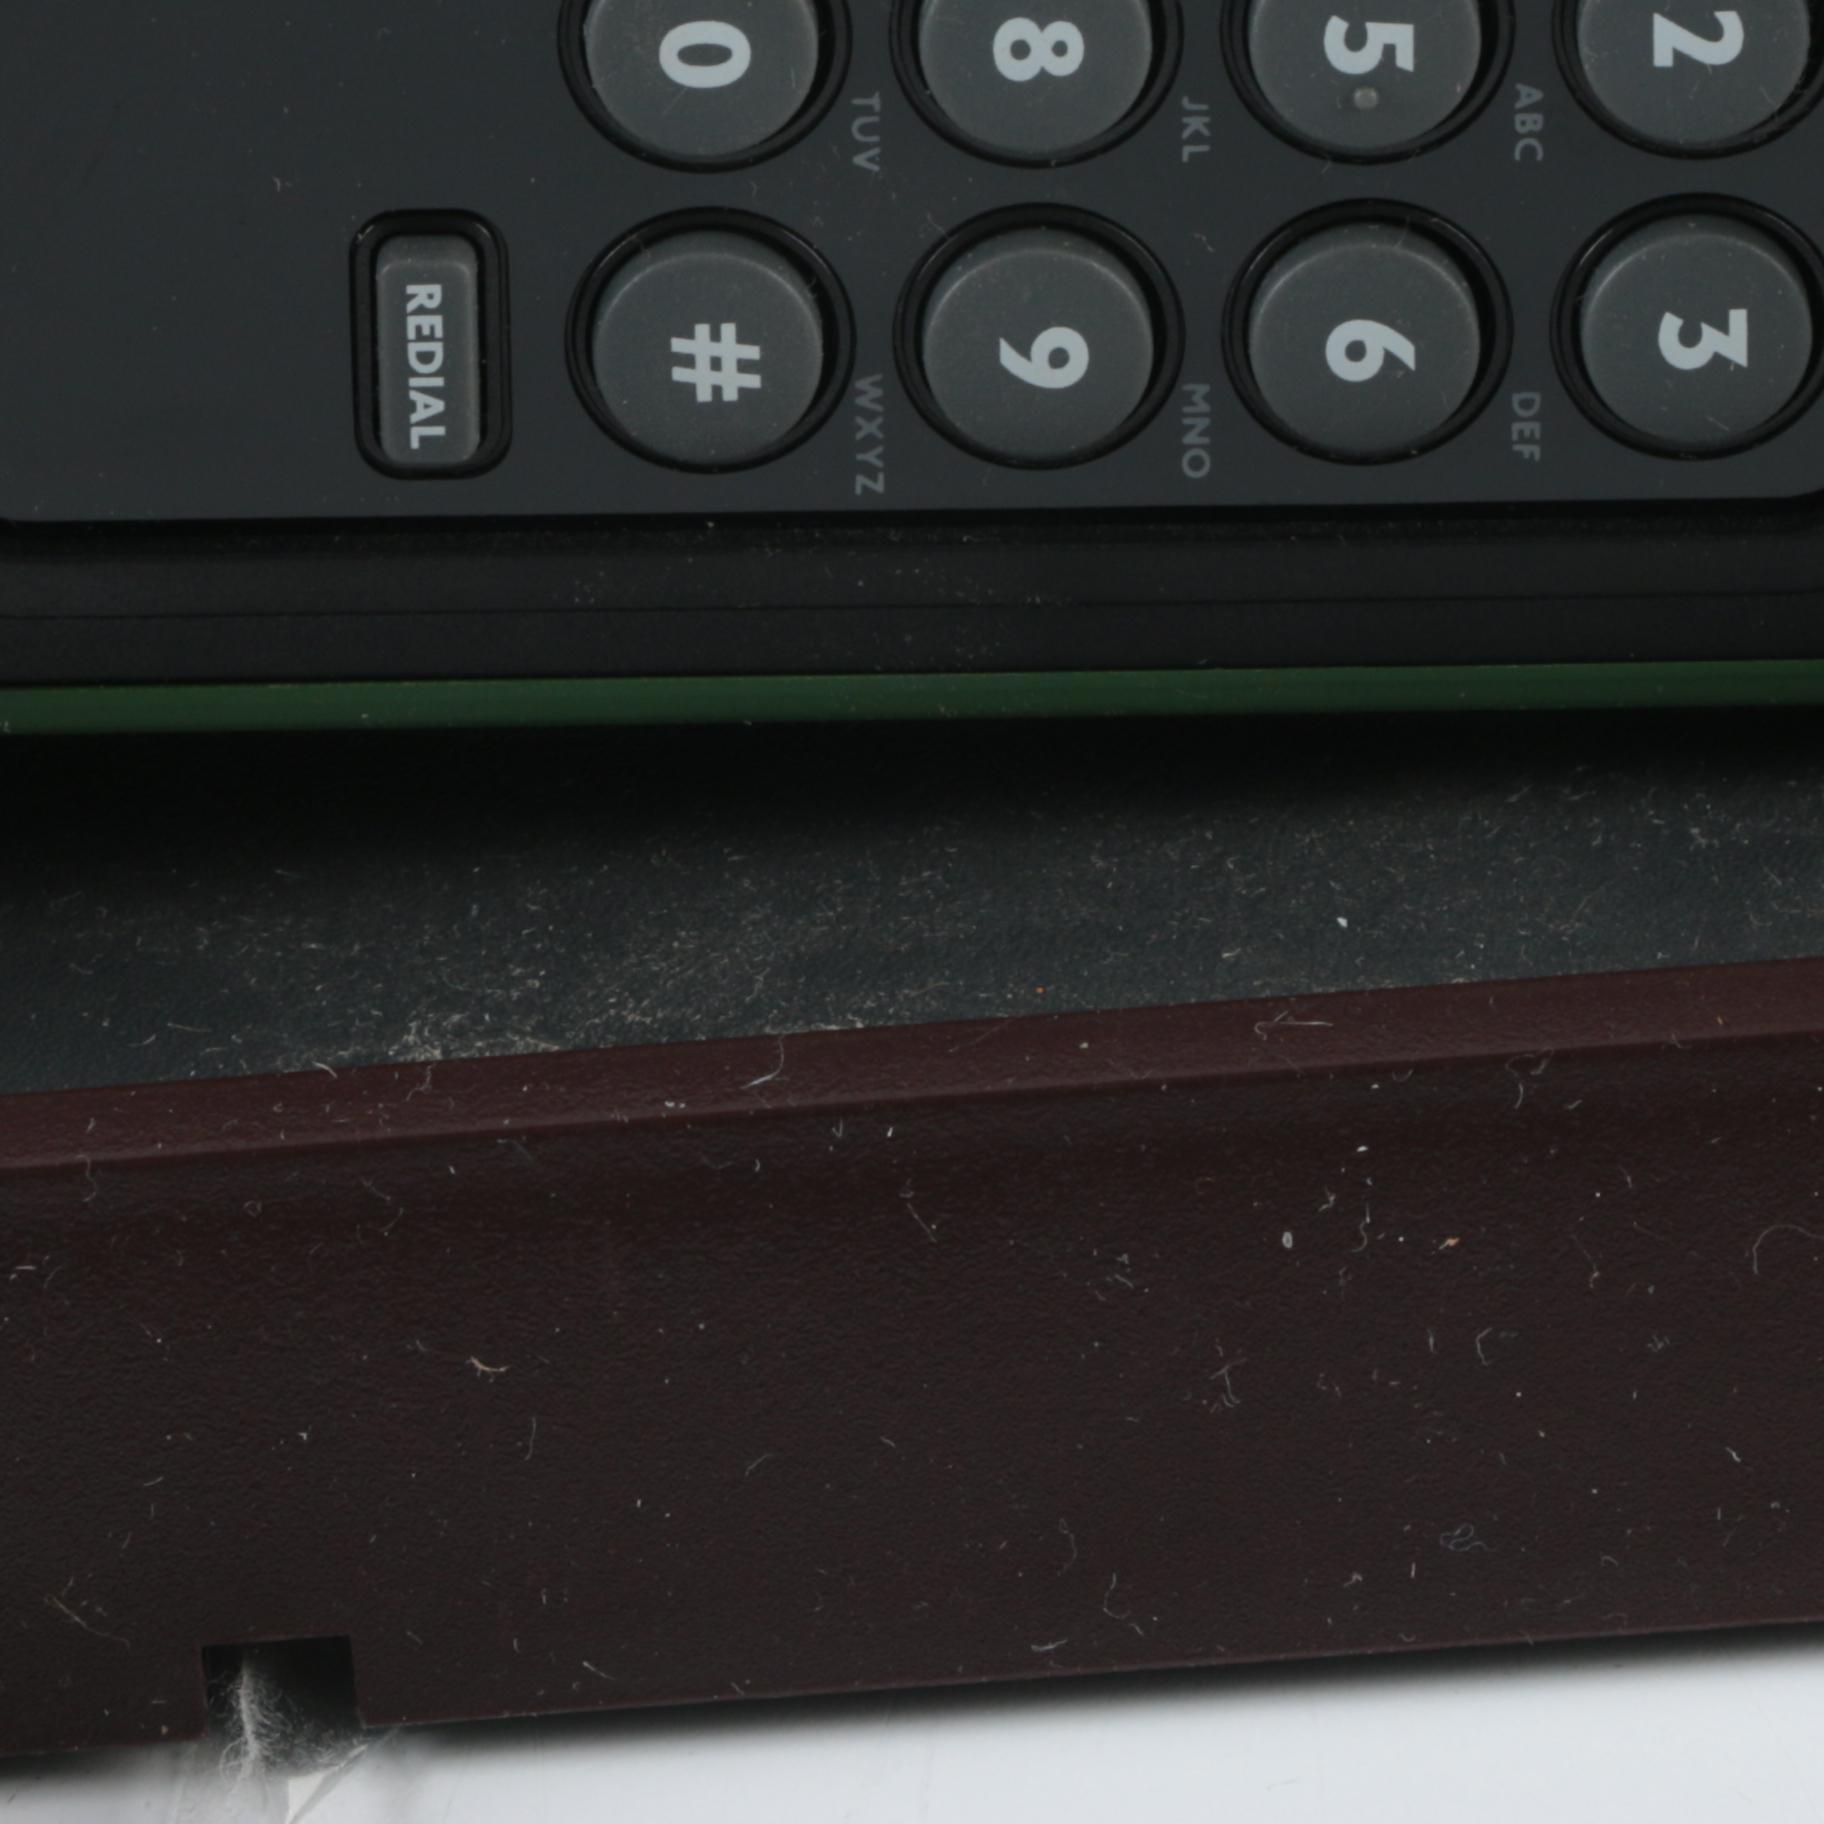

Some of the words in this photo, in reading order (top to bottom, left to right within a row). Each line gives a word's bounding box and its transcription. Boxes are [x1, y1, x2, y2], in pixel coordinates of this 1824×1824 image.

[659, 20, 751, 88] 0
[993, 17, 1085, 82] 8
[1323, 15, 1414, 75] 5
[1653, 10, 1744, 68] 2
[851, 92, 881, 174] TUV
[1182, 96, 1211, 163] JKL
[1513, 83, 1544, 162] ABC
[406, 284, 446, 450] REDIAL
[998, 326, 1090, 390] 9
[1325, 319, 1416, 382] 6
[1658, 308, 1748, 370] 3
[854, 374, 885, 496] WXYZ
[1181, 383, 1211, 479] MNO
[1511, 391, 1541, 462] DEF
